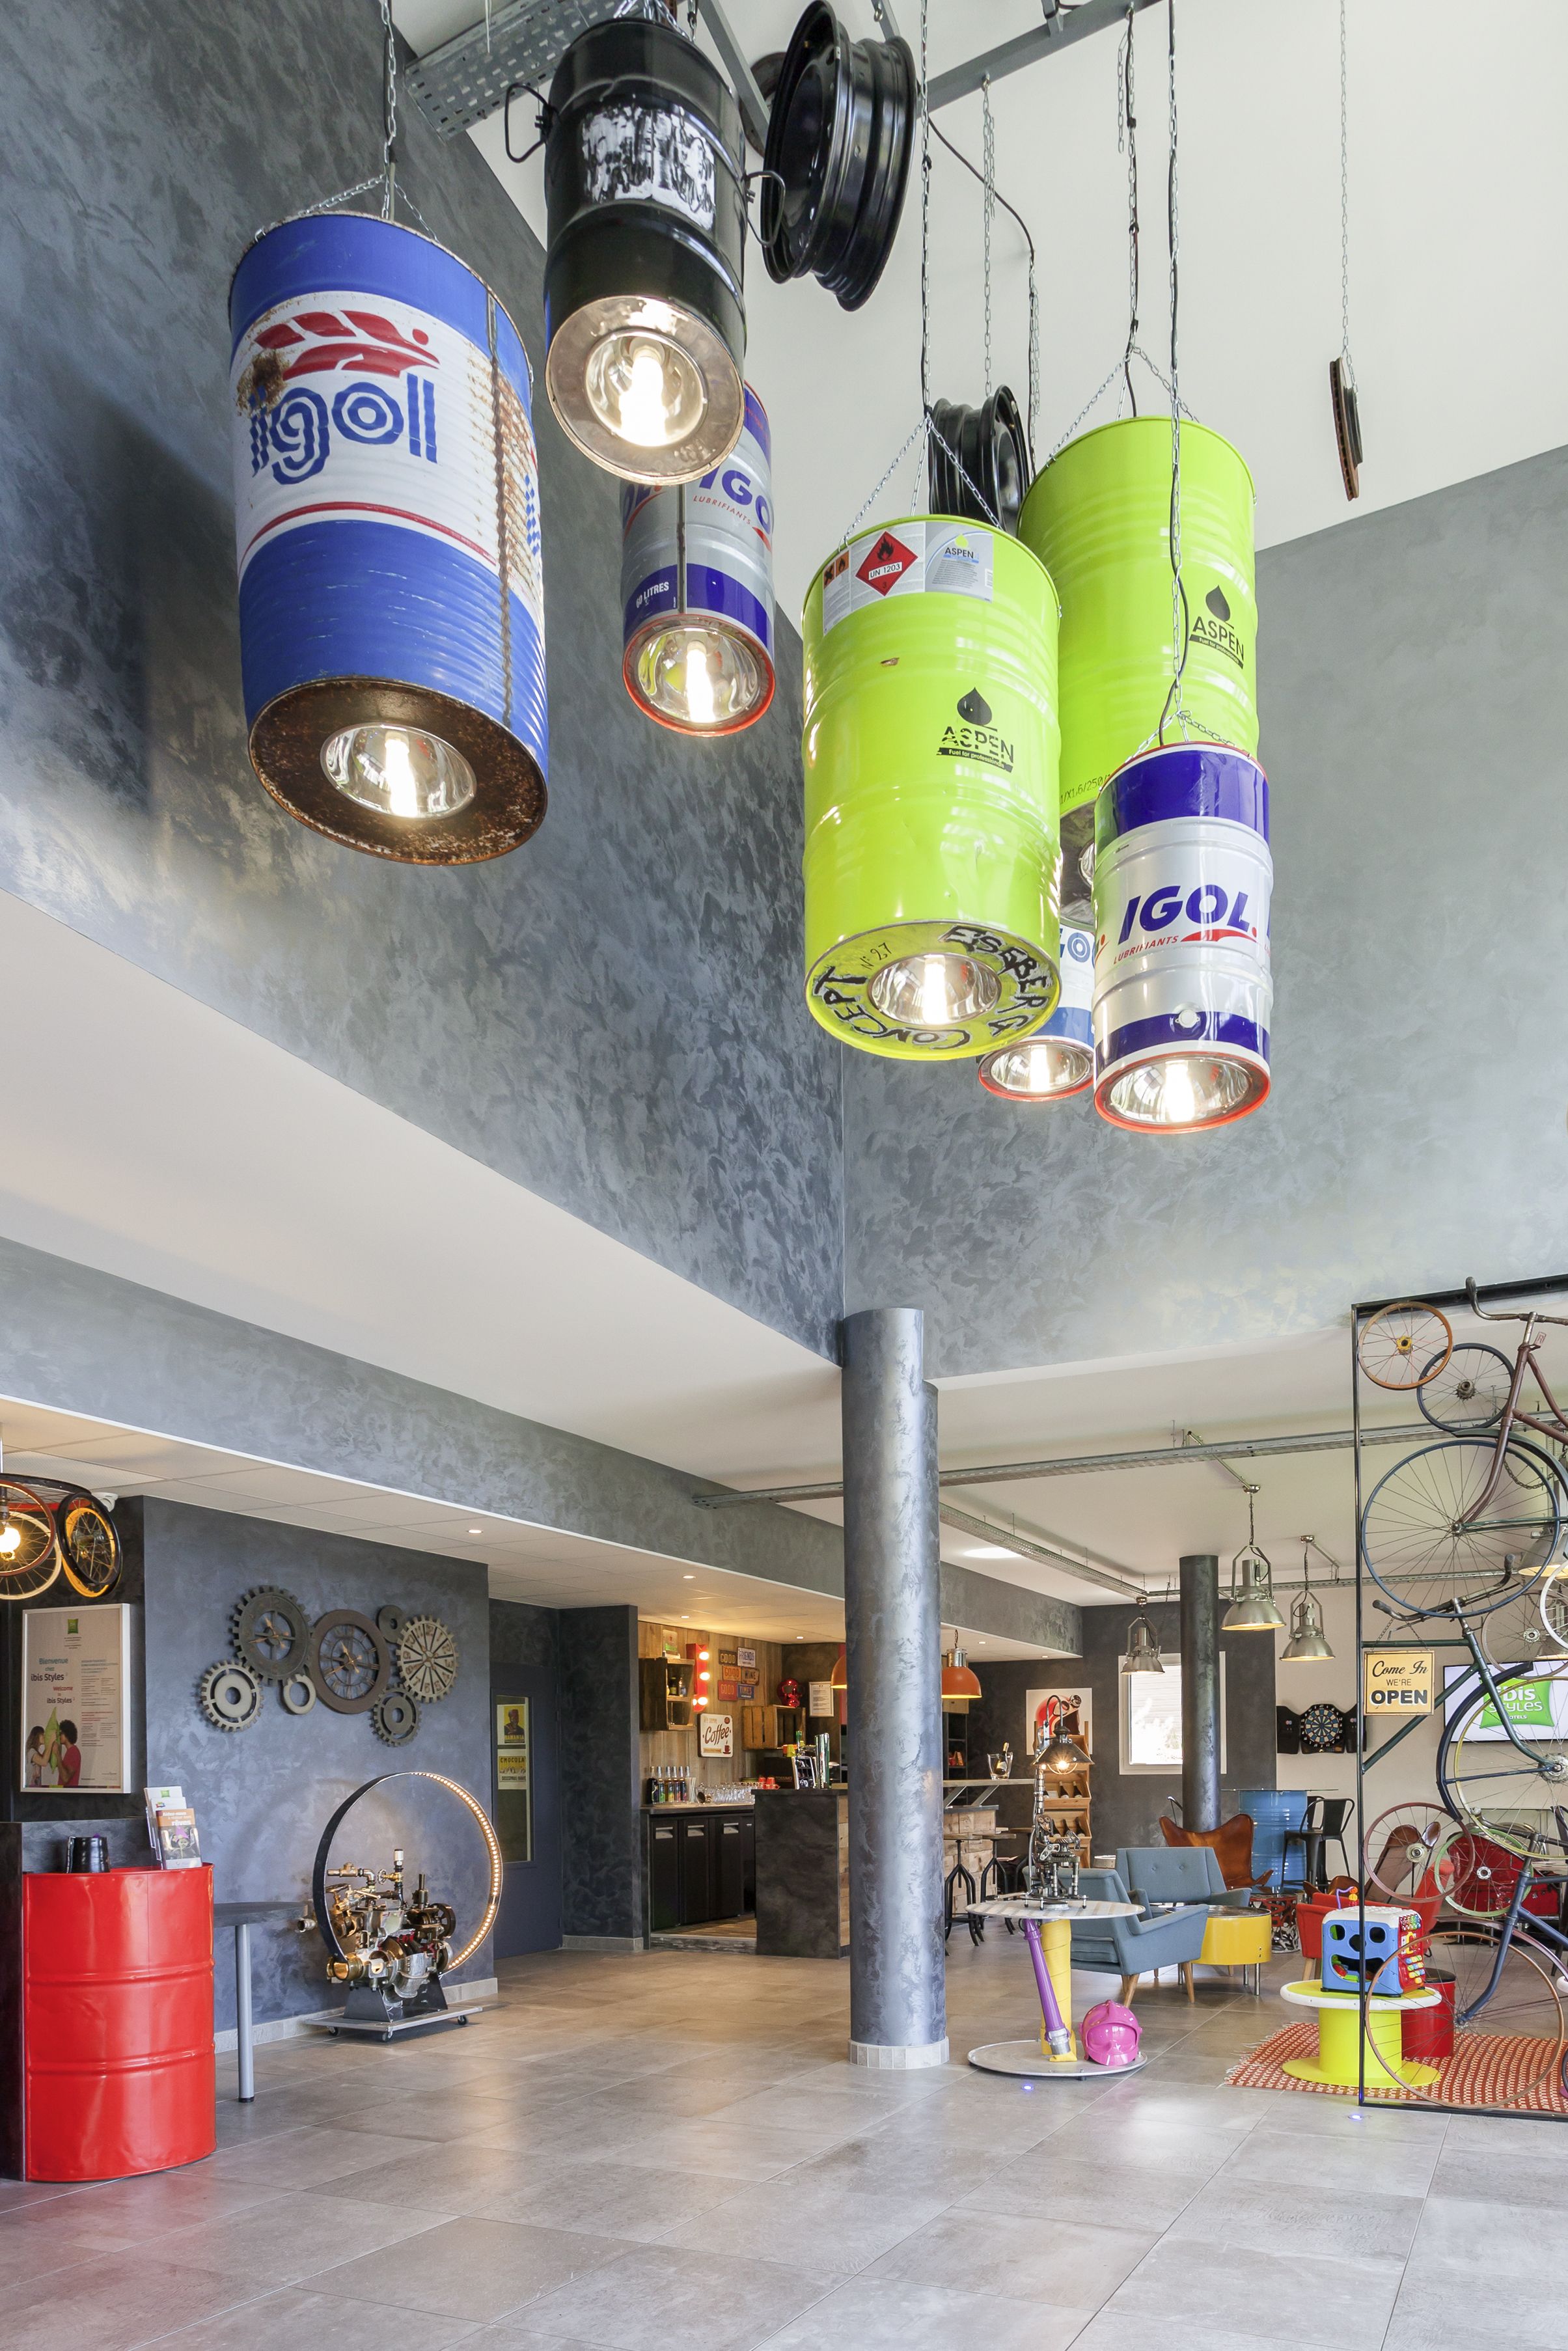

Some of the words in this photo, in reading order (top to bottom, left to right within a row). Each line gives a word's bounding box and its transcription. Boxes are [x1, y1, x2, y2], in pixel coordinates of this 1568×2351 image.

[693, 495, 751, 525] LUBRIFIANTS
[945, 547, 974, 558] ASPEN
[870, 569, 881, 578] UN
[884, 563, 900, 573] 1203
[636, 595, 642, 608] 60
[644, 581, 669, 599] LITRES
[1192, 616, 1244, 662] ASPEN
[941, 726, 1013, 763] ASPEN
[1118, 884, 1250, 946] IGOL
[1113, 935, 1179, 965] LUBRIFIANTS
[814, 966, 970, 1050] CONCEPT
[720, 1653, 736, 1664] GOOD
[44, 1673, 64, 1682] Styles
[724, 1667, 739, 1677] GOOD
[1372, 1660, 1406, 1677] Come
[1409, 1660, 1427, 1674] In
[721, 1684, 735, 1695] GOOD
[1371, 1689, 1427, 1705] OPEN
[705, 1724, 729, 1745] Coffee
